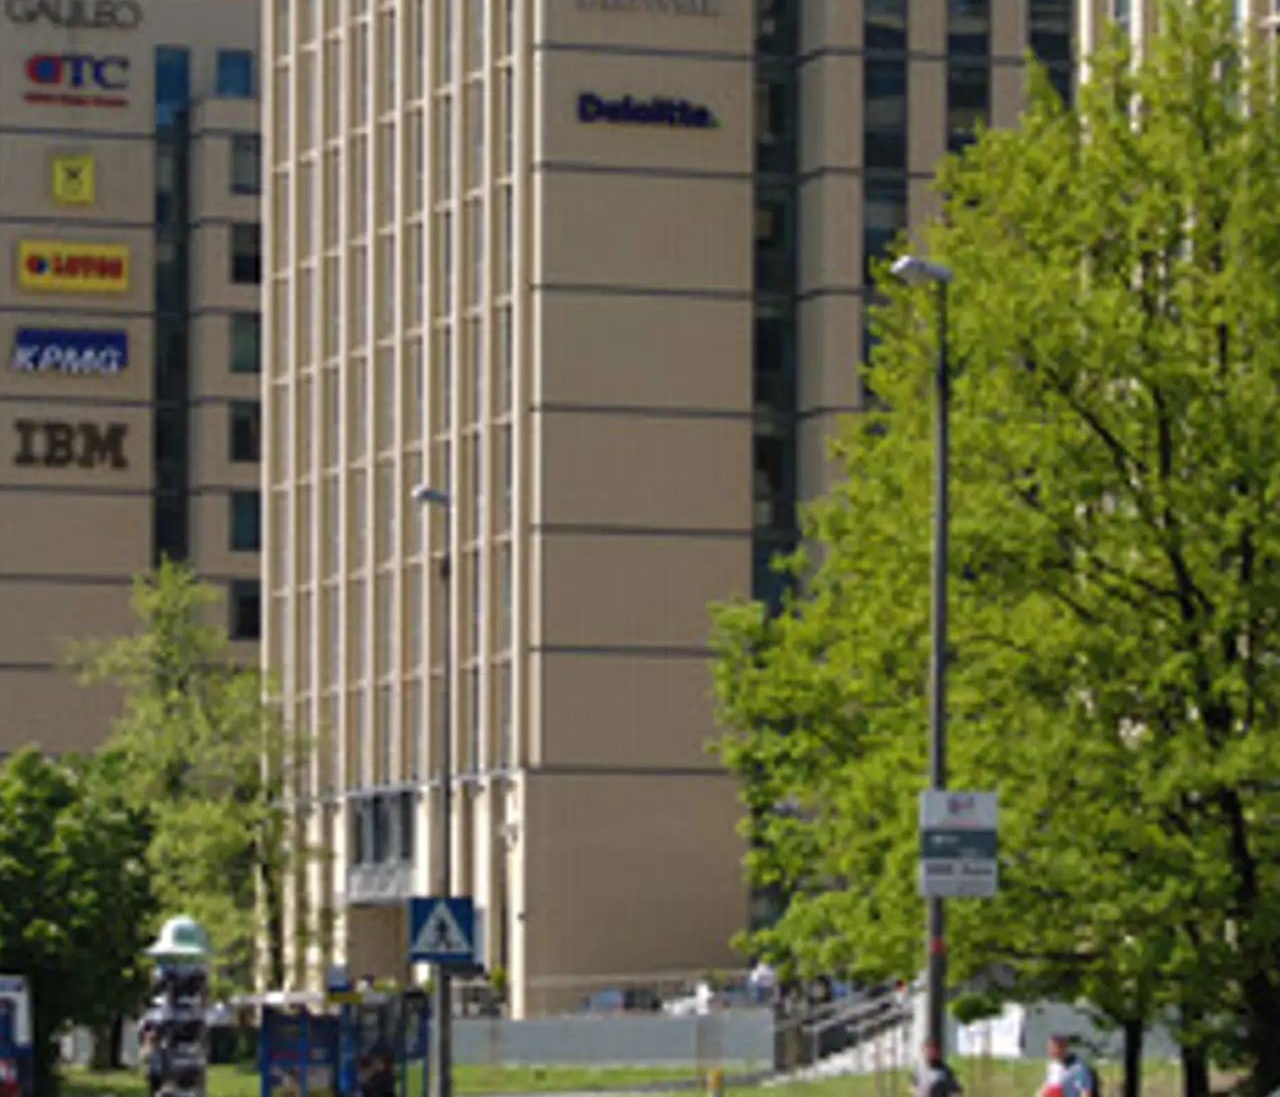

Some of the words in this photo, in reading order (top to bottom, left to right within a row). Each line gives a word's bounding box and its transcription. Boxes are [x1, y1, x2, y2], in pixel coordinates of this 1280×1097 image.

[25, 54, 131, 90] GTC
[10, 343, 124, 375] KPMG
[14, 418, 129, 470] IBM
